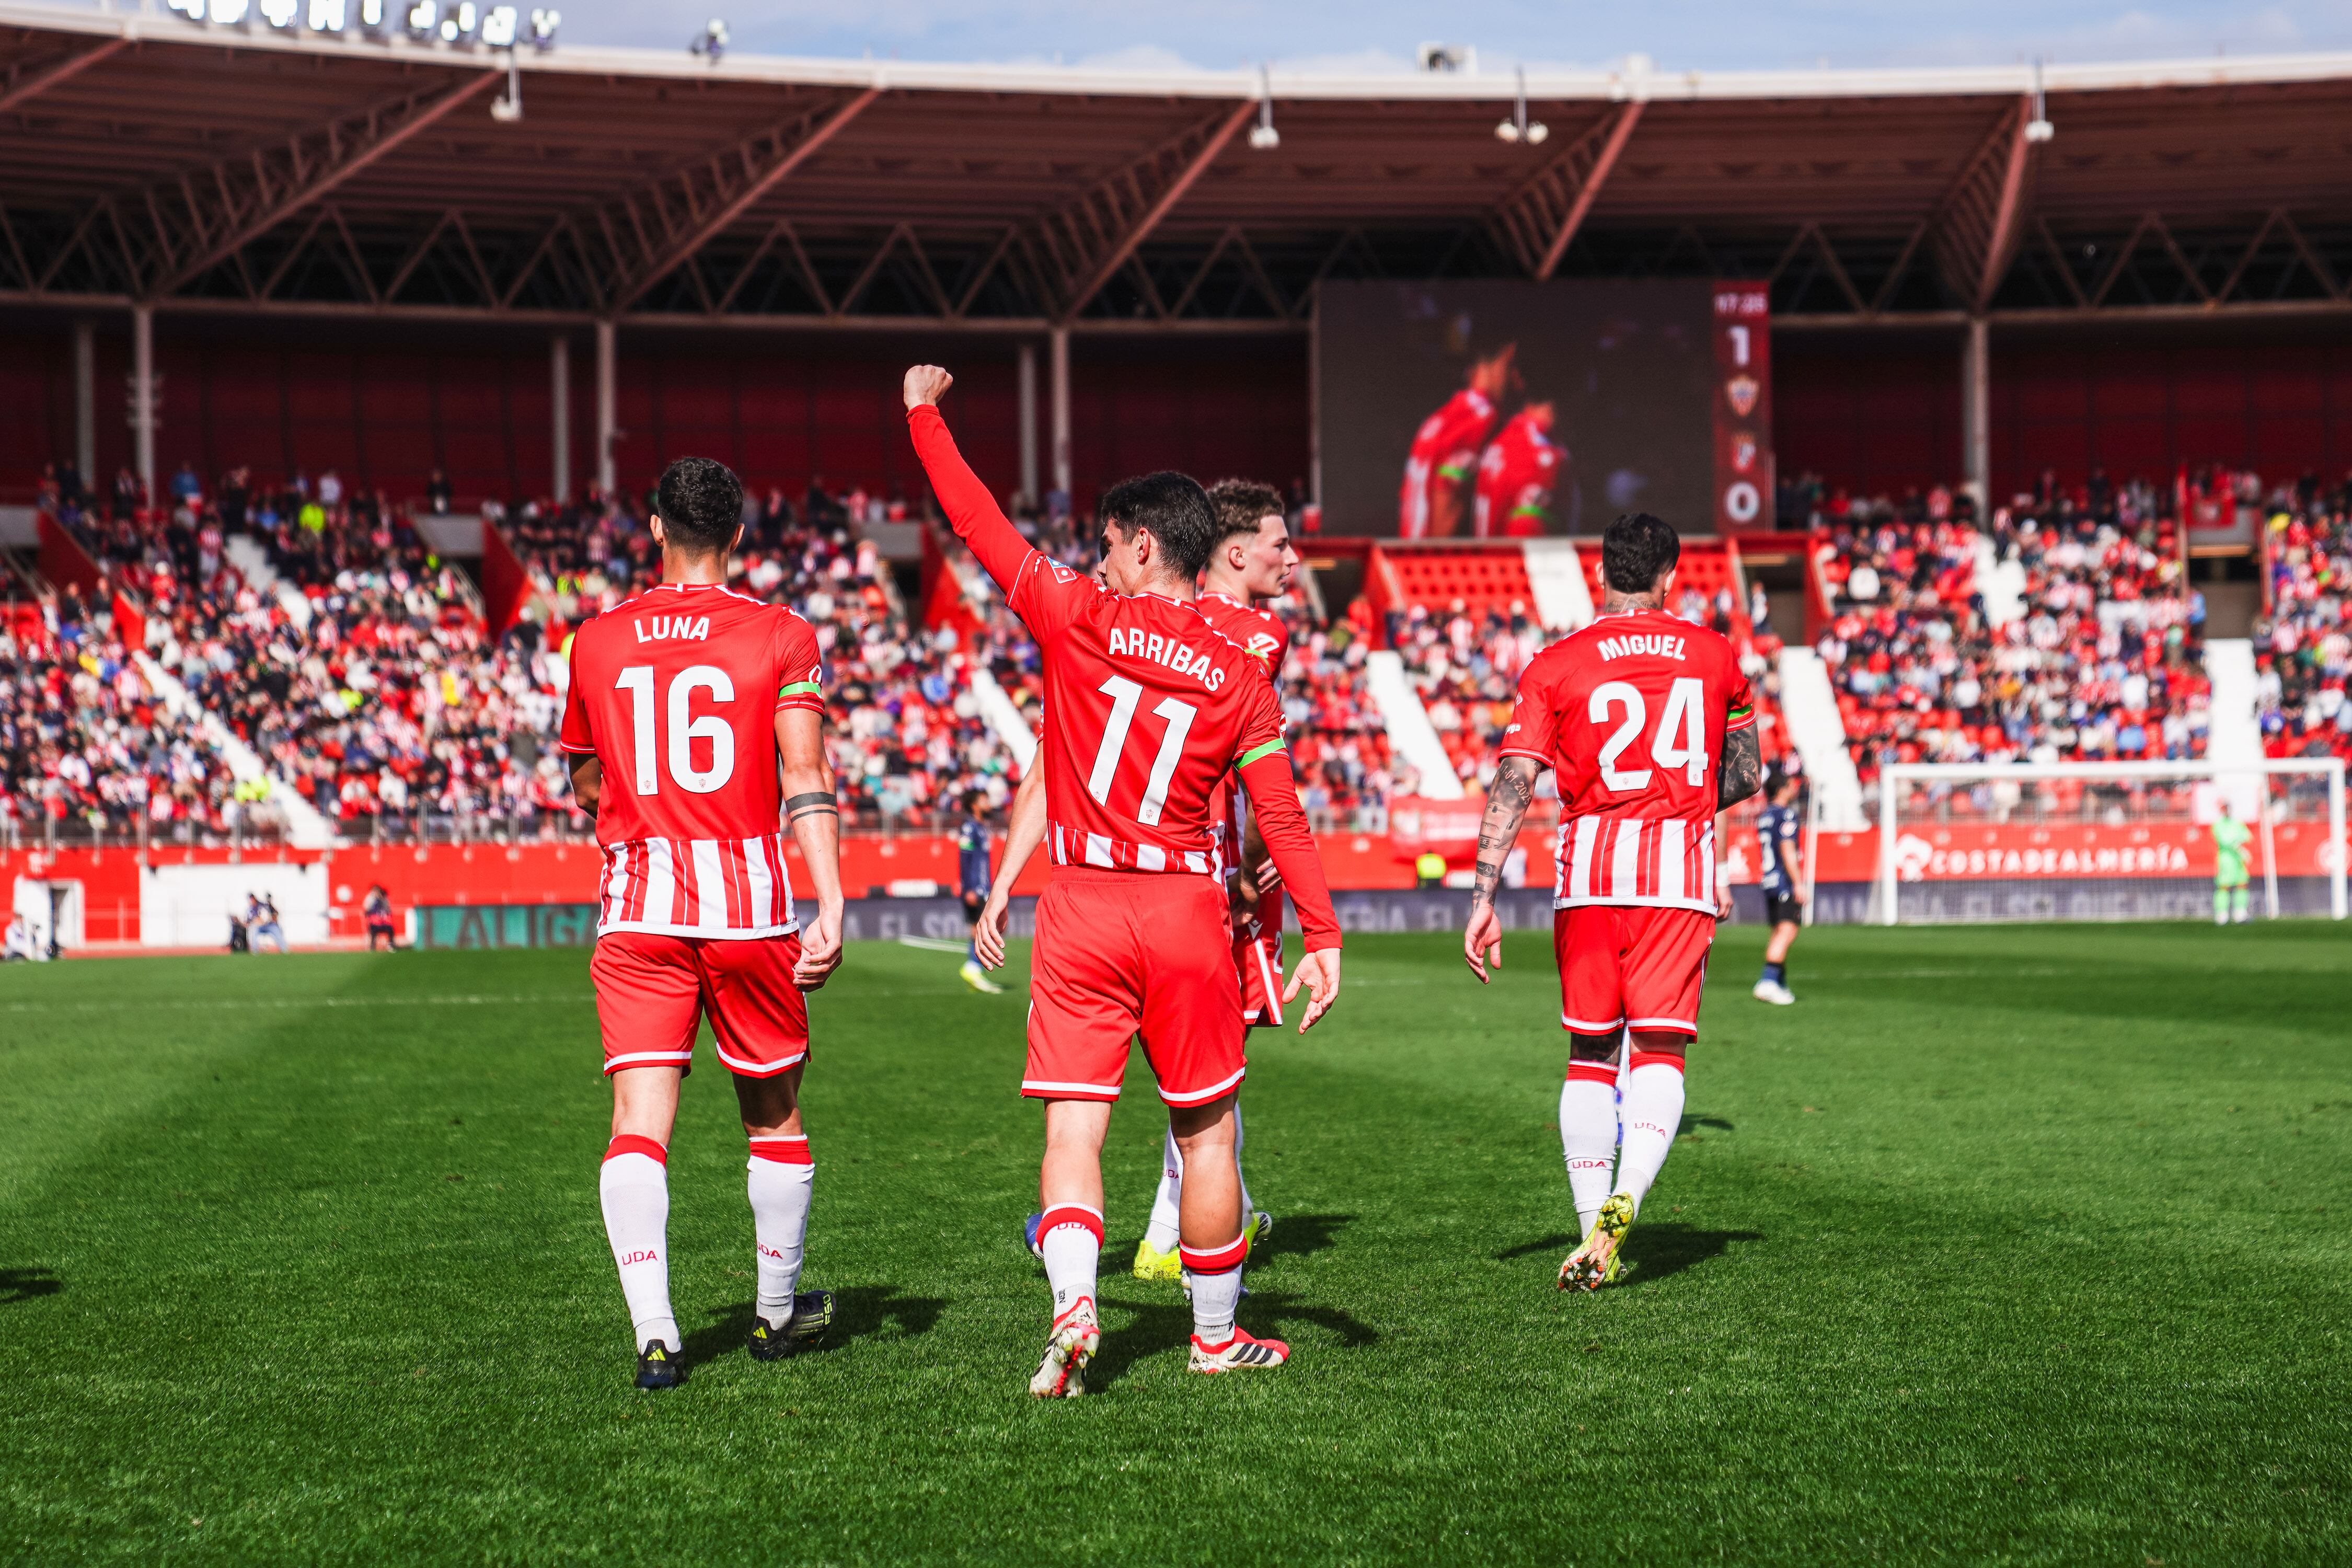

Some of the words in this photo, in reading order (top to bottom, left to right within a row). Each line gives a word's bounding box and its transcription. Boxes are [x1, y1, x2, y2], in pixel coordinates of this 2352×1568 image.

[1728, 326, 1749, 365] 1
[1726, 482, 1760, 522] 0
[635, 616, 710, 643] LUNA
[1109, 628, 1225, 692] ARRIBAS
[1597, 635, 1687, 662] MIGUEL
[614, 665, 735, 796] 16
[1588, 677, 1709, 792] 24
[1088, 674, 1198, 827] 11
[1634, 1122, 1666, 1139] UDA
[621, 1250, 658, 1265] UDA
[757, 1241, 783, 1260] UDA
[823, 1294, 833, 1325] F50
